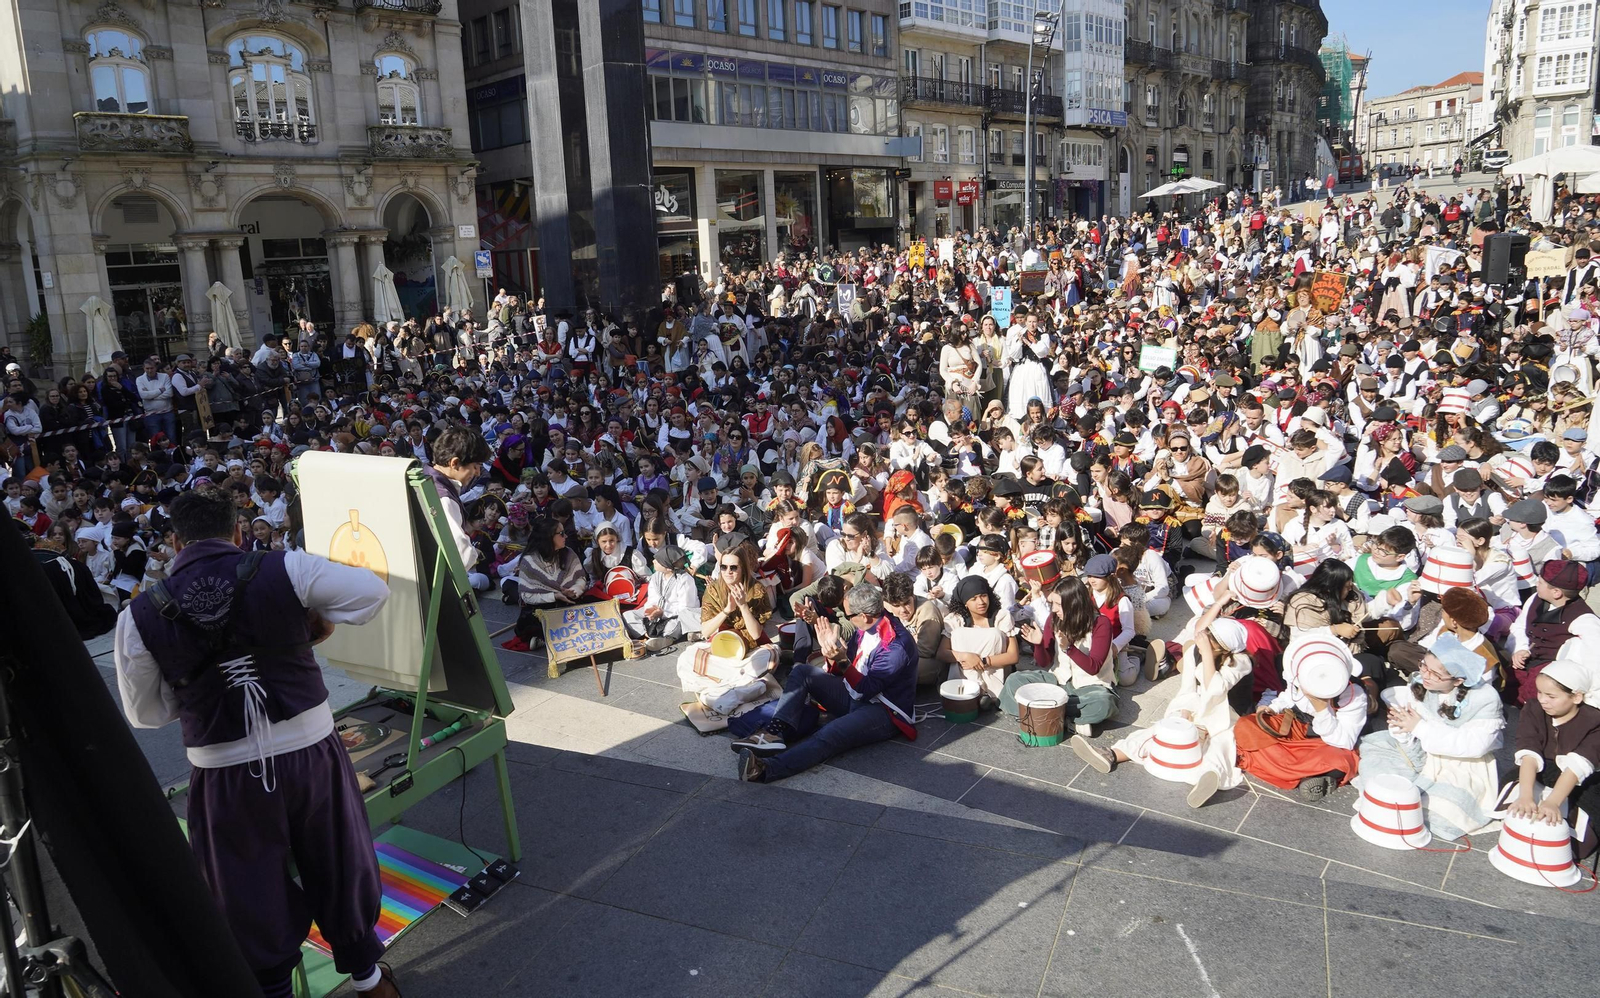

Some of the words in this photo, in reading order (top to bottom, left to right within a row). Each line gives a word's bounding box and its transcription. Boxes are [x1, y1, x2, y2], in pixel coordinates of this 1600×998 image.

[708, 60, 736, 72] OCASO
[823, 74, 847, 85] OCASO
[477, 88, 497, 100] OCASO
[283, 177, 288, 185] 6
[238, 221, 260, 234] ral
[827, 475, 844, 486] N
[1058, 490, 1068, 498] N
[1151, 492, 1161, 502] N
[549, 618, 620, 641] MOSTEIRO
[553, 630, 620, 653] BEMBRIVE
